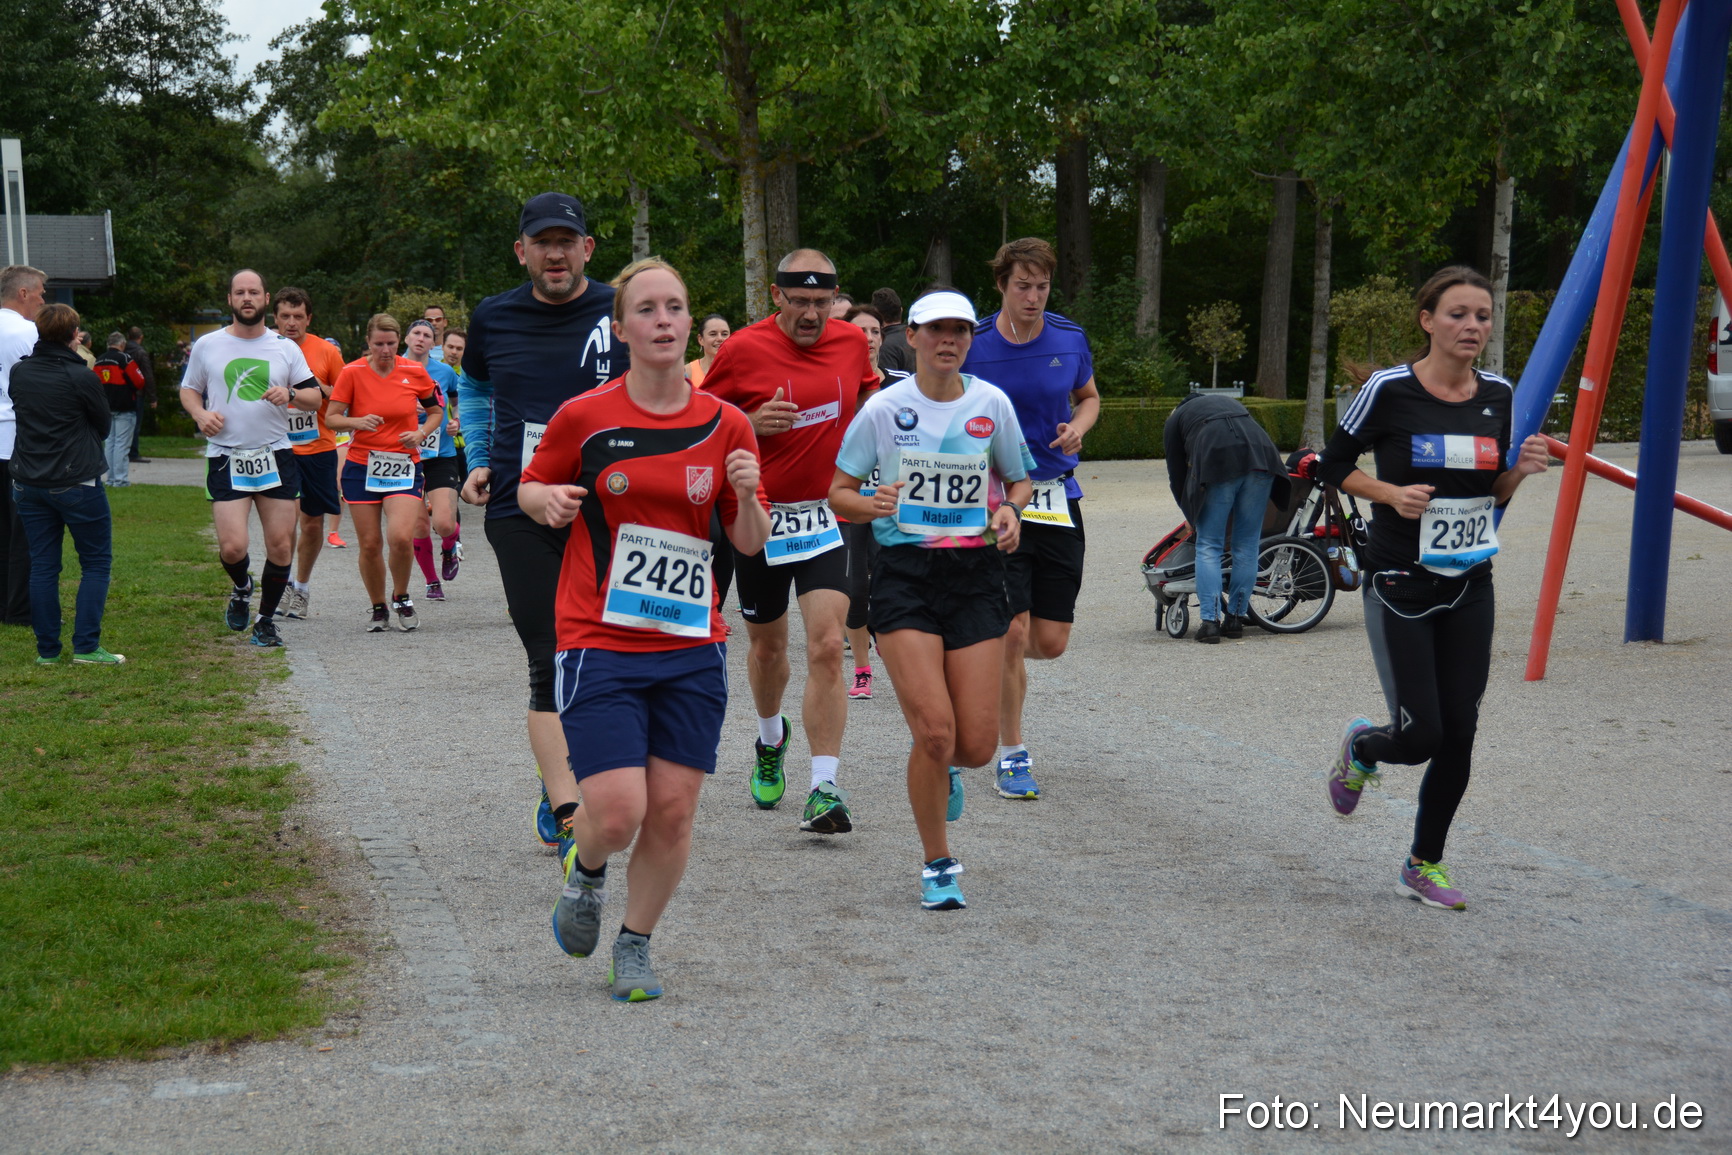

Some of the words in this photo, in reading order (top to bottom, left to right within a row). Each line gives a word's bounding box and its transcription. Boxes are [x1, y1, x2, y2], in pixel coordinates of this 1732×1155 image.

[805, 409, 827, 421] DEHN
[969, 421, 993, 433] Hervis
[894, 434, 920, 442] PARTL
[235, 455, 271, 475] 3031
[372, 461, 411, 477] 2224
[902, 457, 932, 468] PARTL
[934, 460, 977, 471] Neumarkt
[908, 471, 982, 505] 2182
[922, 510, 963, 525] Natalie
[1424, 506, 1456, 515] PARTL
[769, 506, 830, 537] 2574
[1430, 514, 1490, 550] 2392
[620, 533, 657, 548] PARTL
[659, 540, 700, 558] Neumarkt
[786, 538, 821, 552] Helmut
[622, 550, 706, 600] 2426
[639, 599, 682, 620] Nicole
